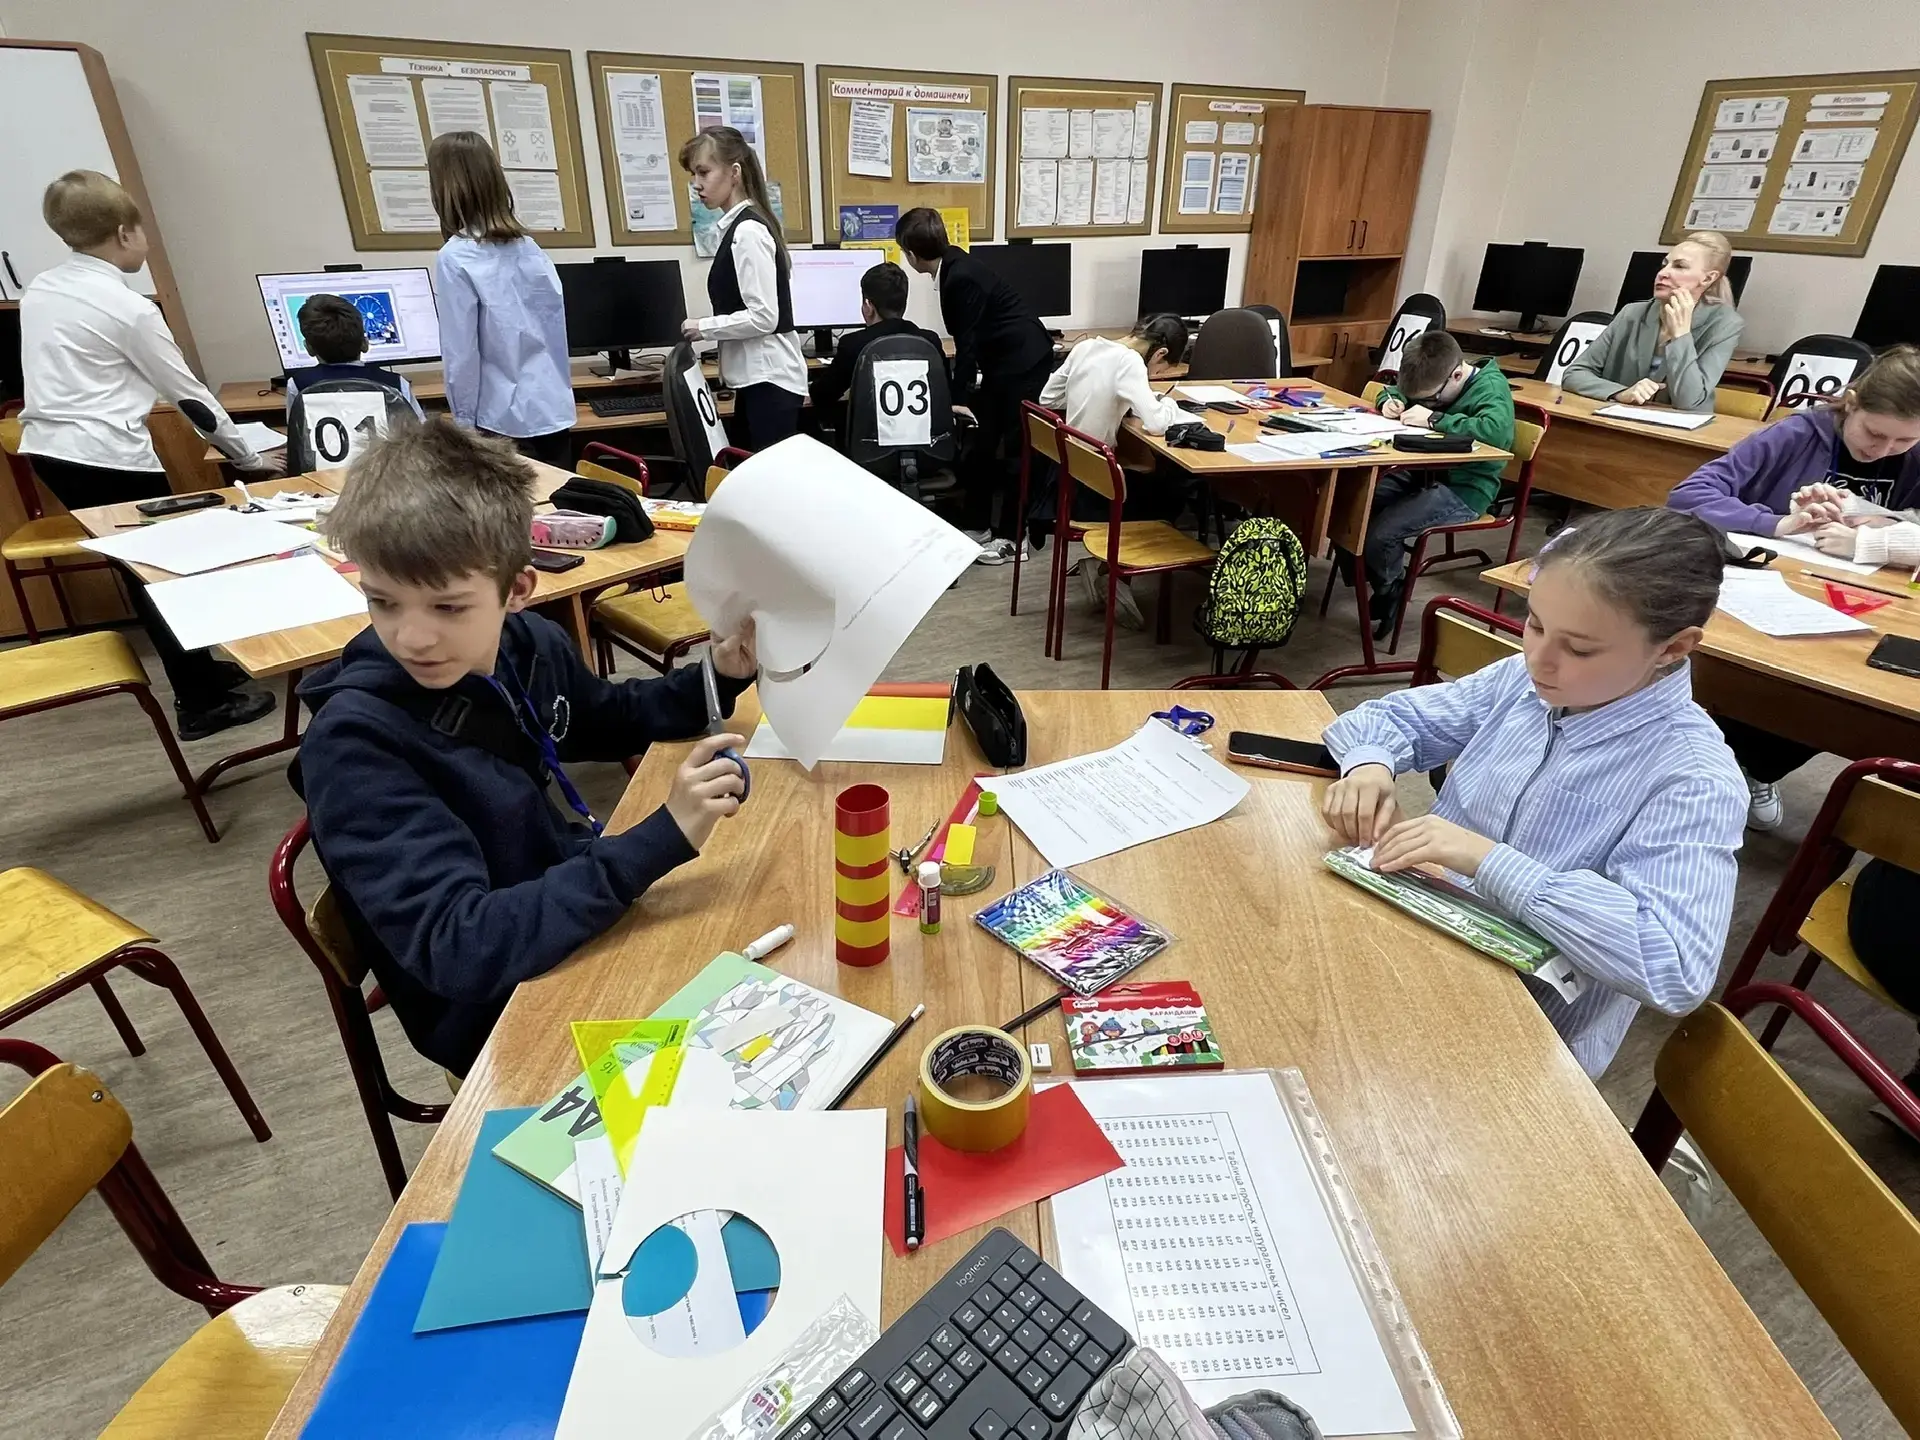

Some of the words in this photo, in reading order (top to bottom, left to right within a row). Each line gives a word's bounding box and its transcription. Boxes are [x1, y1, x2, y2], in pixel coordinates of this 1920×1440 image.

[834, 84, 904, 98] Комментарий
[914, 90, 969, 102] домашнему
[879, 379, 929, 417] 03
[1226, 1150, 1244, 1186] Таблица
[1239, 1187, 1258, 1224] простых
[1252, 1226, 1280, 1288] натуральных
[1276, 1289, 1292, 1320] чисел
[956, 1254, 990, 1288] logitech
